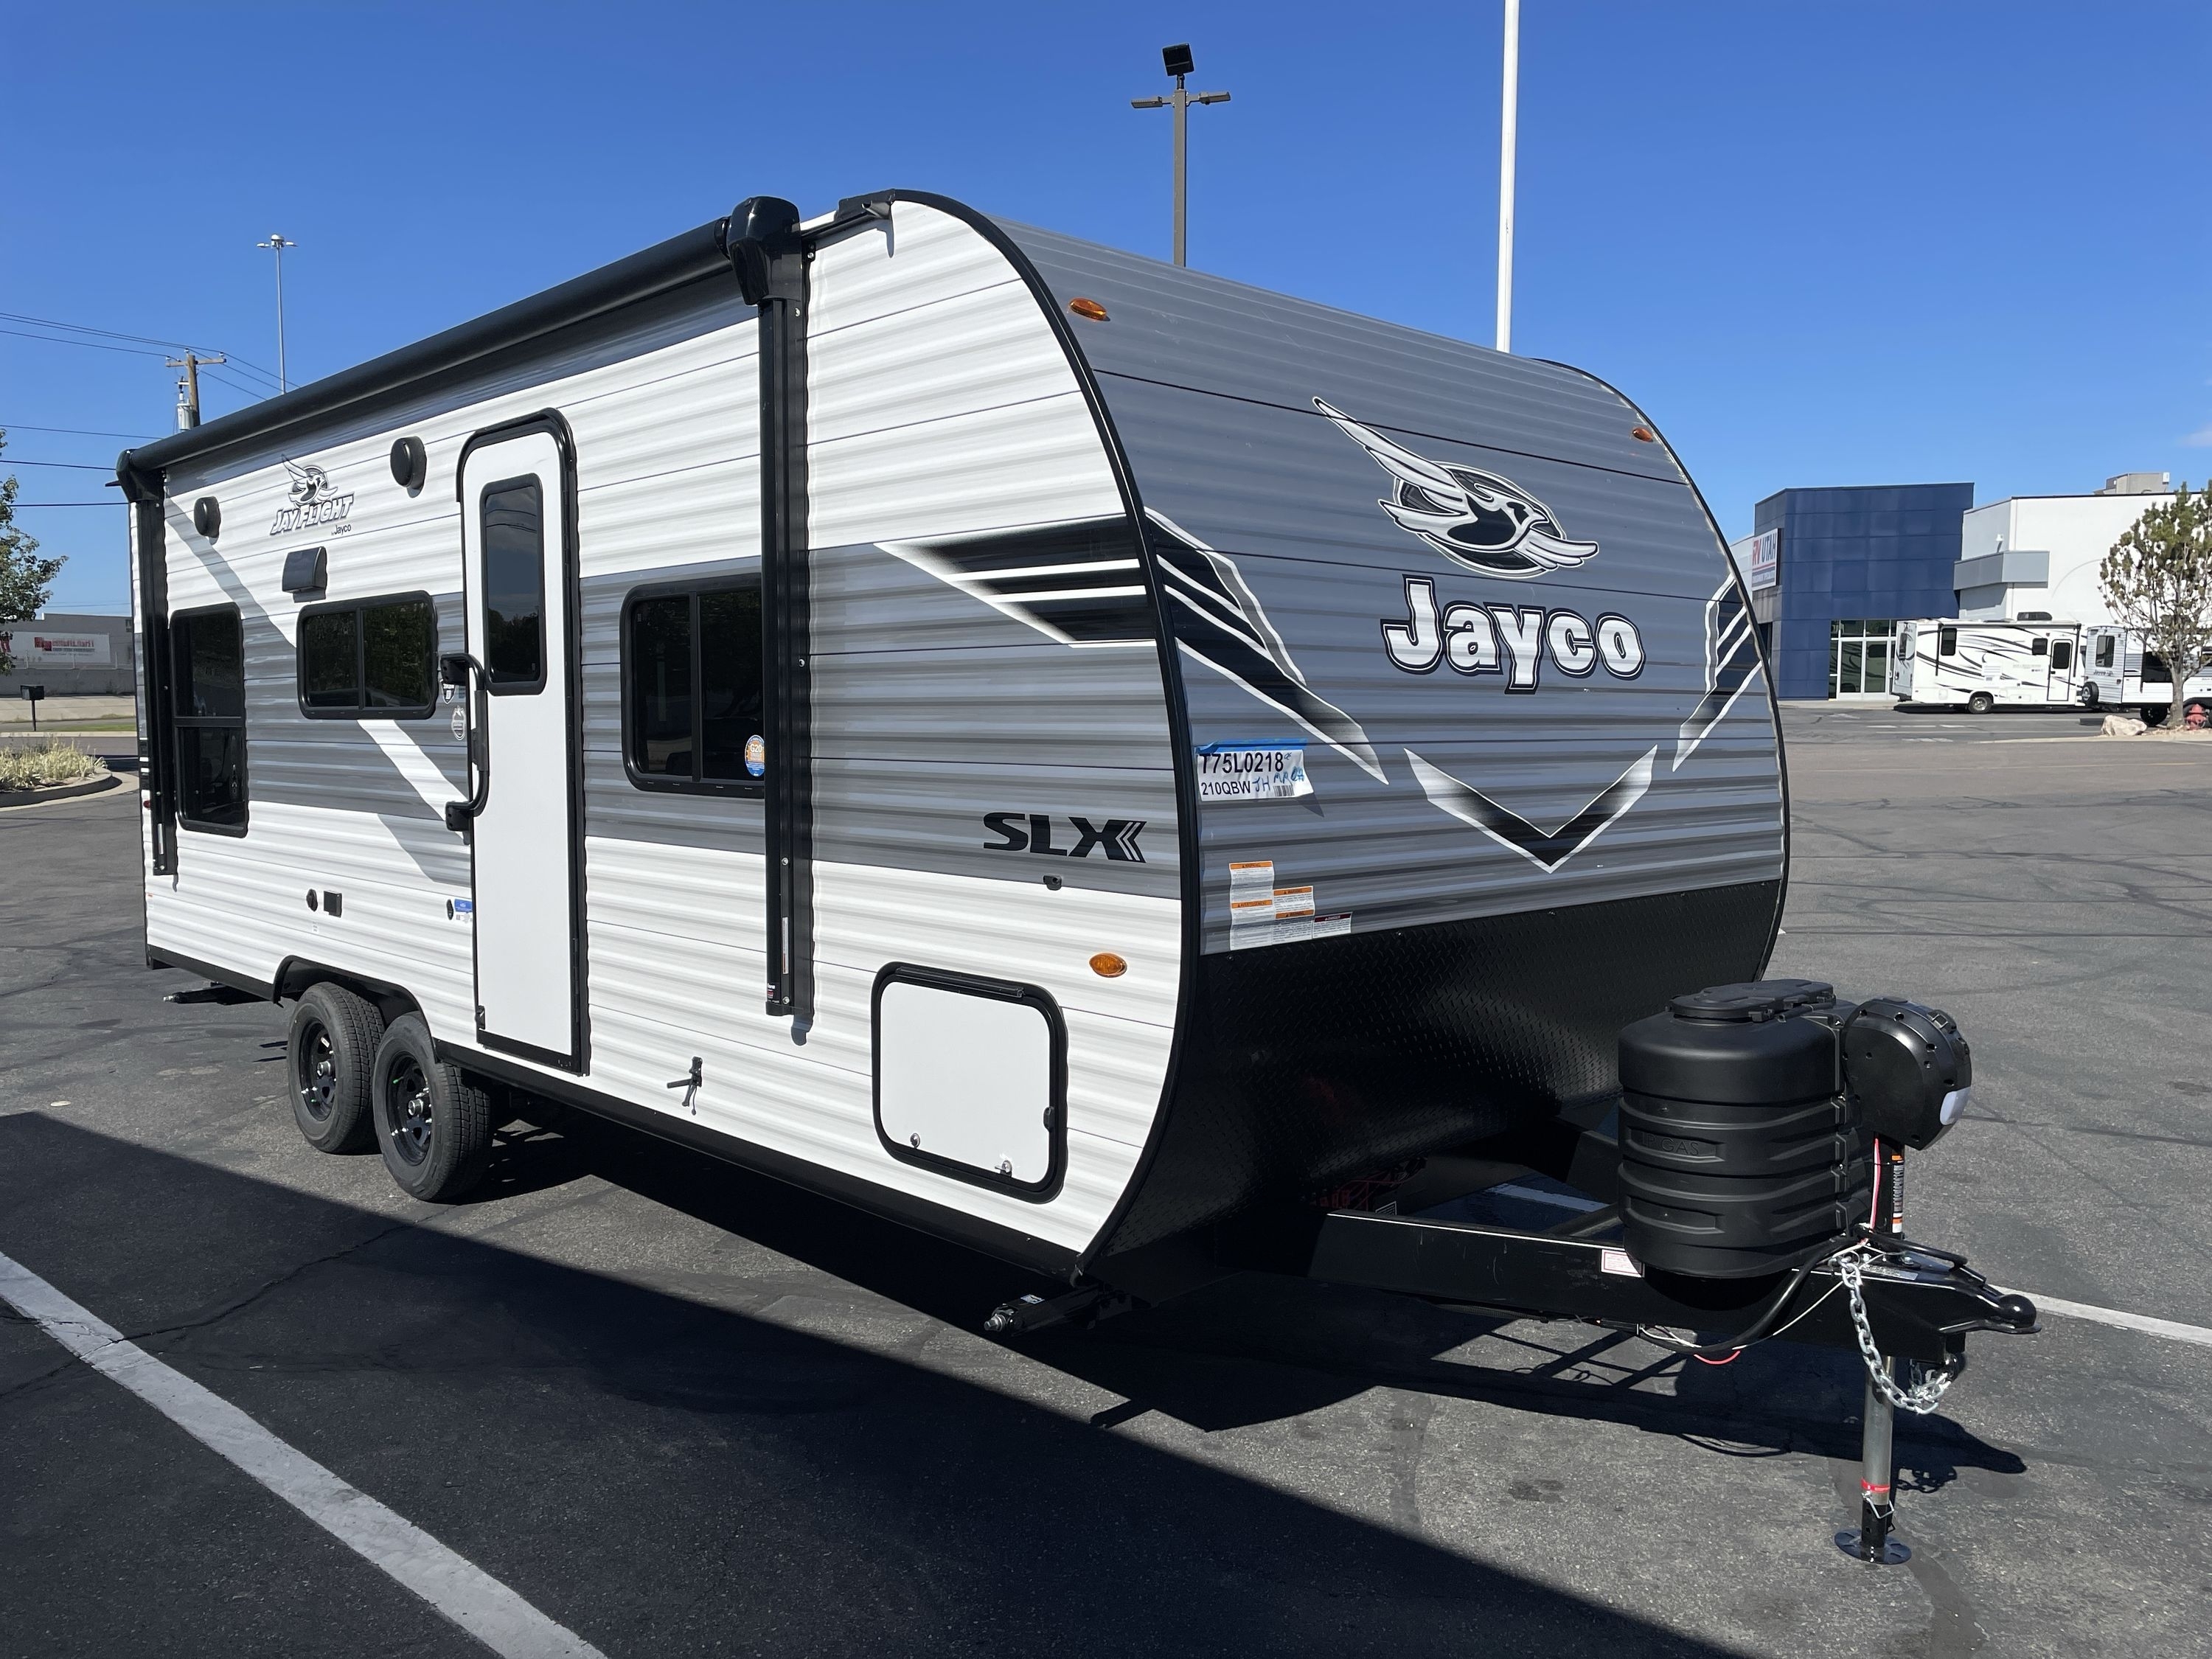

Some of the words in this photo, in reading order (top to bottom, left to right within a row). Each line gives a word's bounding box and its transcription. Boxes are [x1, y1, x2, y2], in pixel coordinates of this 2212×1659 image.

[270, 507, 299, 535] JAY
[296, 493, 354, 529] FLIGHT
[334, 524, 352, 535] Jayco
[1761, 532, 1777, 563] UTAH
[1380, 574, 1646, 695] Jayco
[750, 743, 762, 753] G20
[1199, 751, 1284, 774] T75L0218
[1200, 780, 1251, 796] 210QBW
[983, 812, 1147, 863] SLX
[1661, 1137, 1700, 1156] GAS
